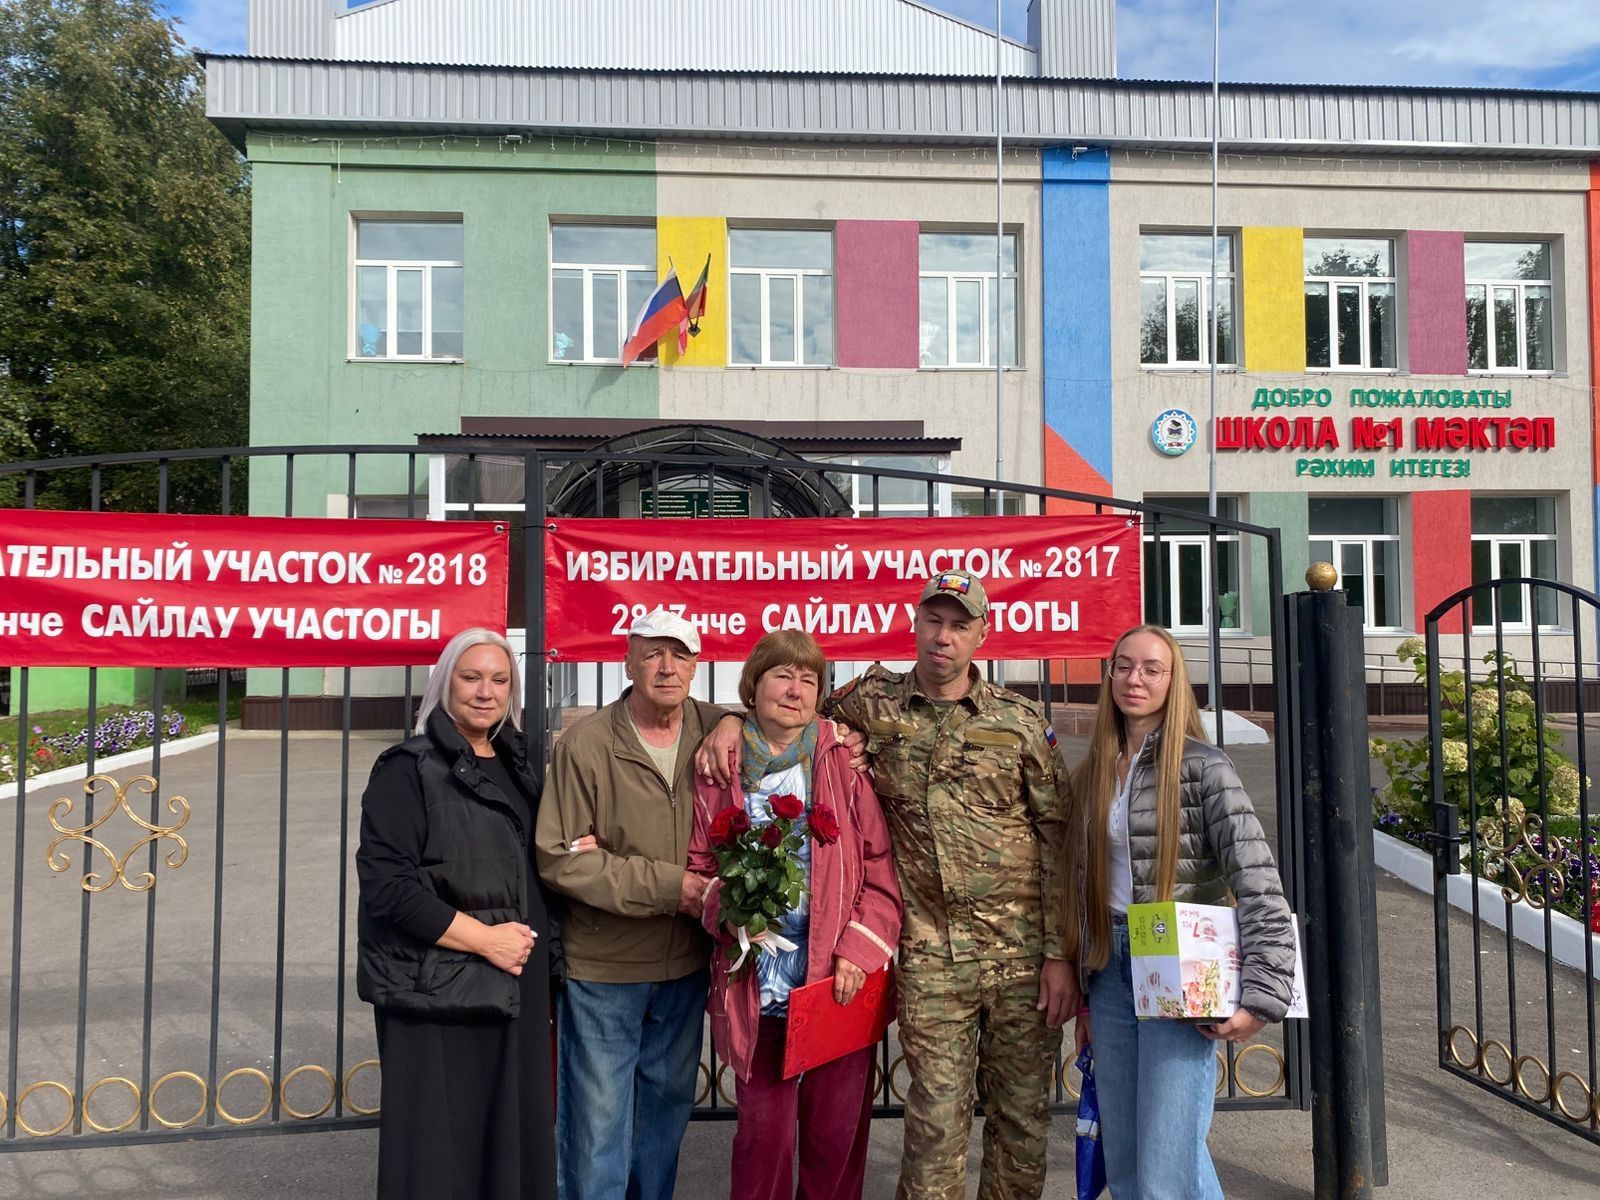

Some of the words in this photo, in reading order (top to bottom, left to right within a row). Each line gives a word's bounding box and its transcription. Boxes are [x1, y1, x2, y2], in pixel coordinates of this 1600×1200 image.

[1251, 388, 1332, 411] ДОБРО
[1350, 388, 1512, 408] ПОЖАЛОВАТЬ!
[1215, 416, 1340, 449] ШКОЛА
[1351, 416, 1404, 449] №1
[1415, 416, 1556, 449] МӘКТӘП
[1296, 458, 1375, 478] РӘХИМ
[1390, 458, 1471, 478] ИТЕГЕЗ!
[0, 541, 192, 581] ТЕЛЬНЫЙ
[203, 550, 373, 584] УЧАСТОК
[378, 552, 487, 586] №2818
[566, 543, 854, 582] ИЗБИРАТЕЛЬНЫЙ
[861, 548, 1012, 580] УЧАСТОК
[1019, 545, 1120, 578] №2817
[0, 612, 64, 637] нче
[81, 597, 240, 638] САЙЛАУ
[247, 606, 441, 640] УЧАСТОГЫ
[761, 596, 897, 634] САЙЛАУ
[903, 601, 1079, 633] УТОГЫ
